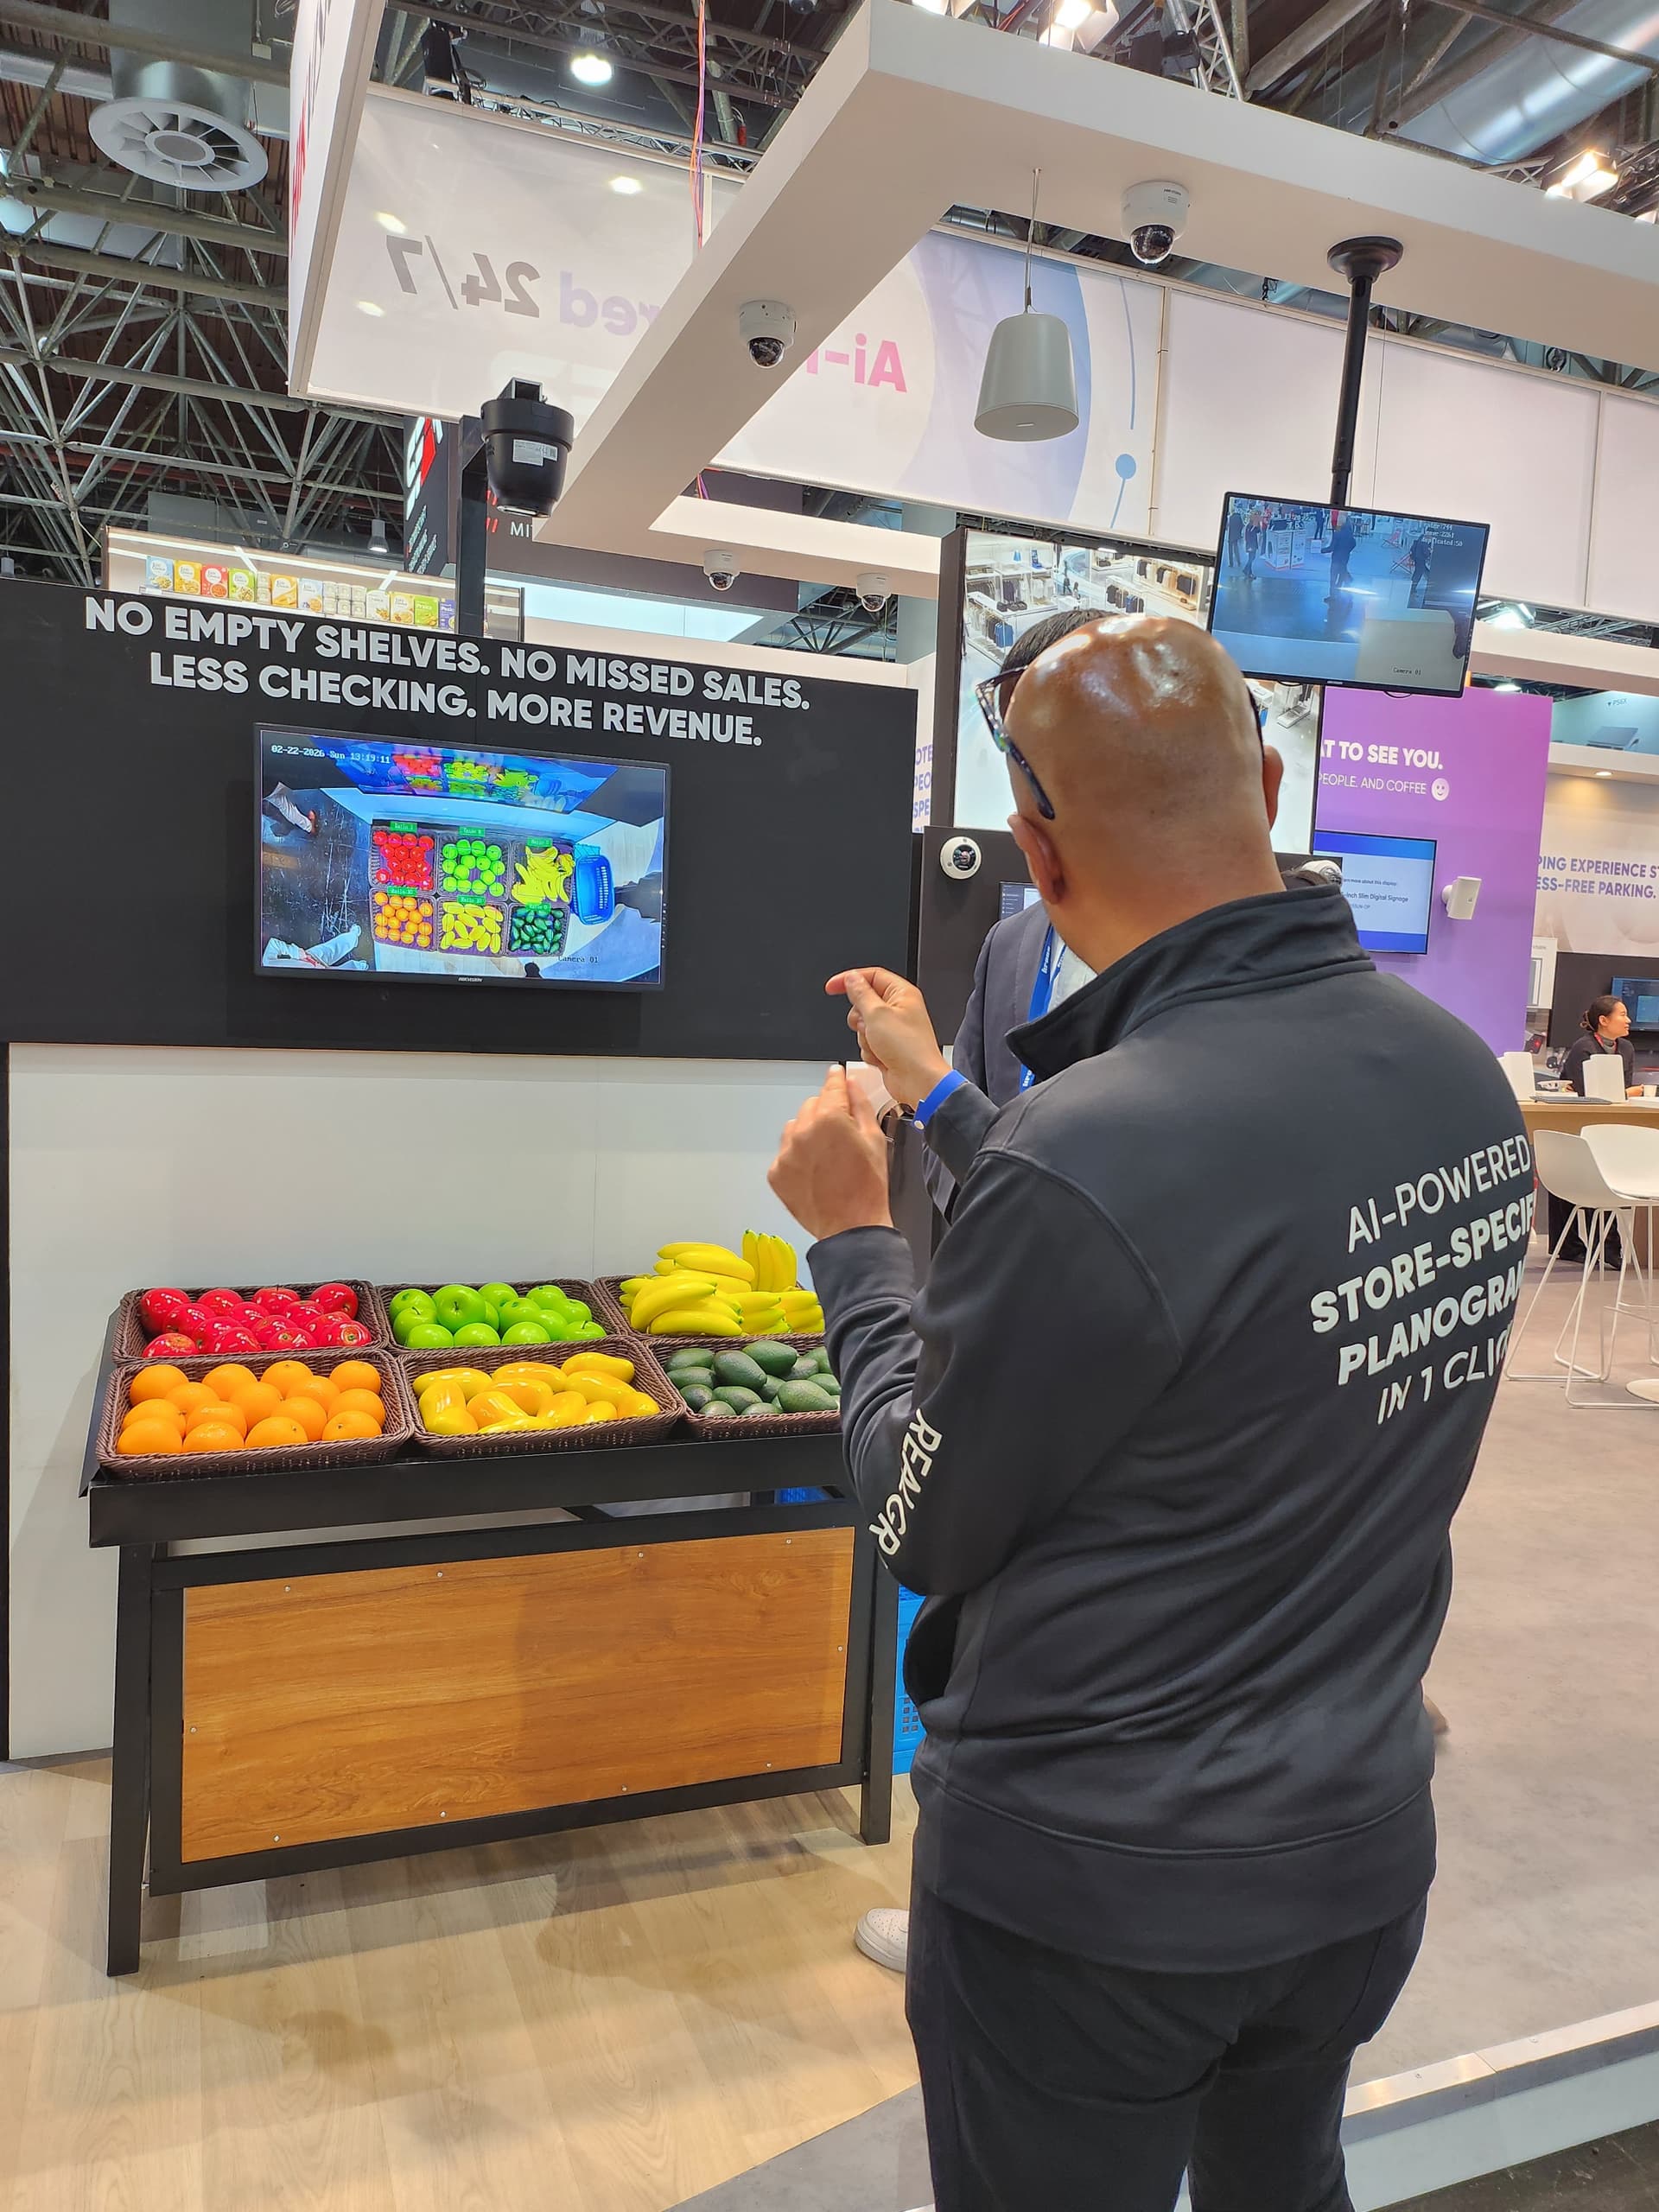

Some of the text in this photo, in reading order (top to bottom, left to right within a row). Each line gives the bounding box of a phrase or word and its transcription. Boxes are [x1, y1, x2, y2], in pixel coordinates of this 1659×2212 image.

[511, 521, 532, 538] MI
[86, 596, 810, 710] NO EMPTY SHELVES. NO MISSED SALES.
[150, 652, 764, 747] LESS CHECKING. MORE REVENUE.
[270, 745, 391, 764] 02-22-2026 Sun 13:19:11
[1338, 741, 1364, 761] TO
[1367, 744, 1400, 766] SEE
[1402, 747, 1444, 771] YOU.
[1360, 777, 1384, 791] AND
[1386, 779, 1427, 795] COFFEE
[1570, 857, 1648, 878] EXPERIENCE
[1370, 893, 1388, 902] Digital
[1388, 895, 1409, 904] Signage
[1598, 880, 1657, 899] PARKING.
[1348, 1134, 1532, 1254] AI-POWERED
[1377, 1375, 1413, 1426] IN
[1421, 1365, 1433, 1402] 1
